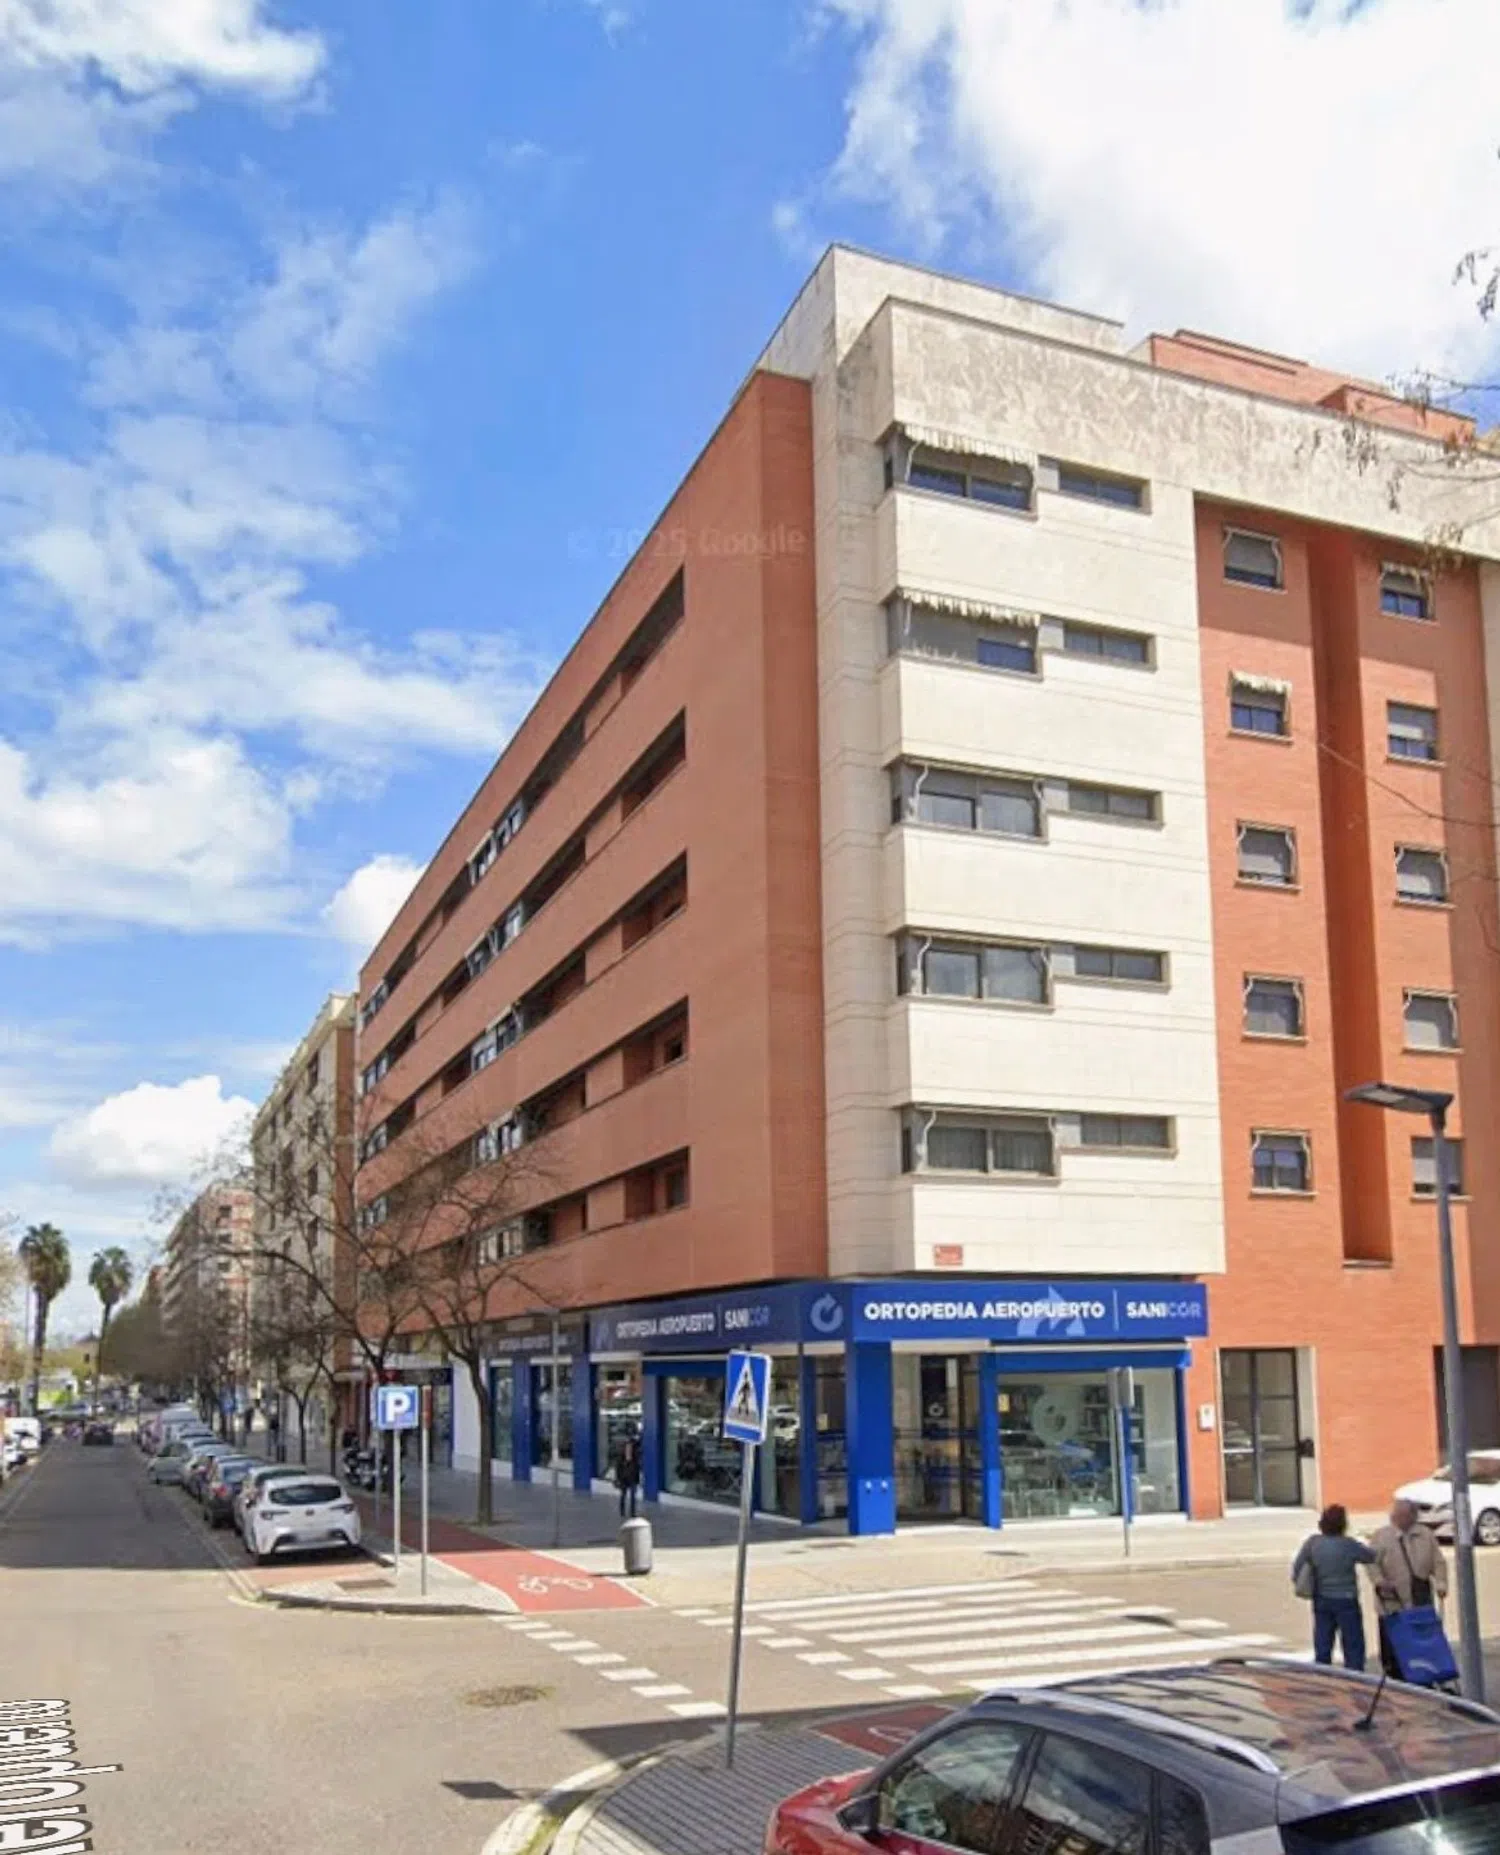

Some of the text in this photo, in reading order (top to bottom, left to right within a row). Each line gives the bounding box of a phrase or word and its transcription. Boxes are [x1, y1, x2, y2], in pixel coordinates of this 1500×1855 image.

[864, 1301, 1202, 1321] ORTOPEDIA AEROPUERTO SANICOR
[385, 1391, 412, 1422] P
